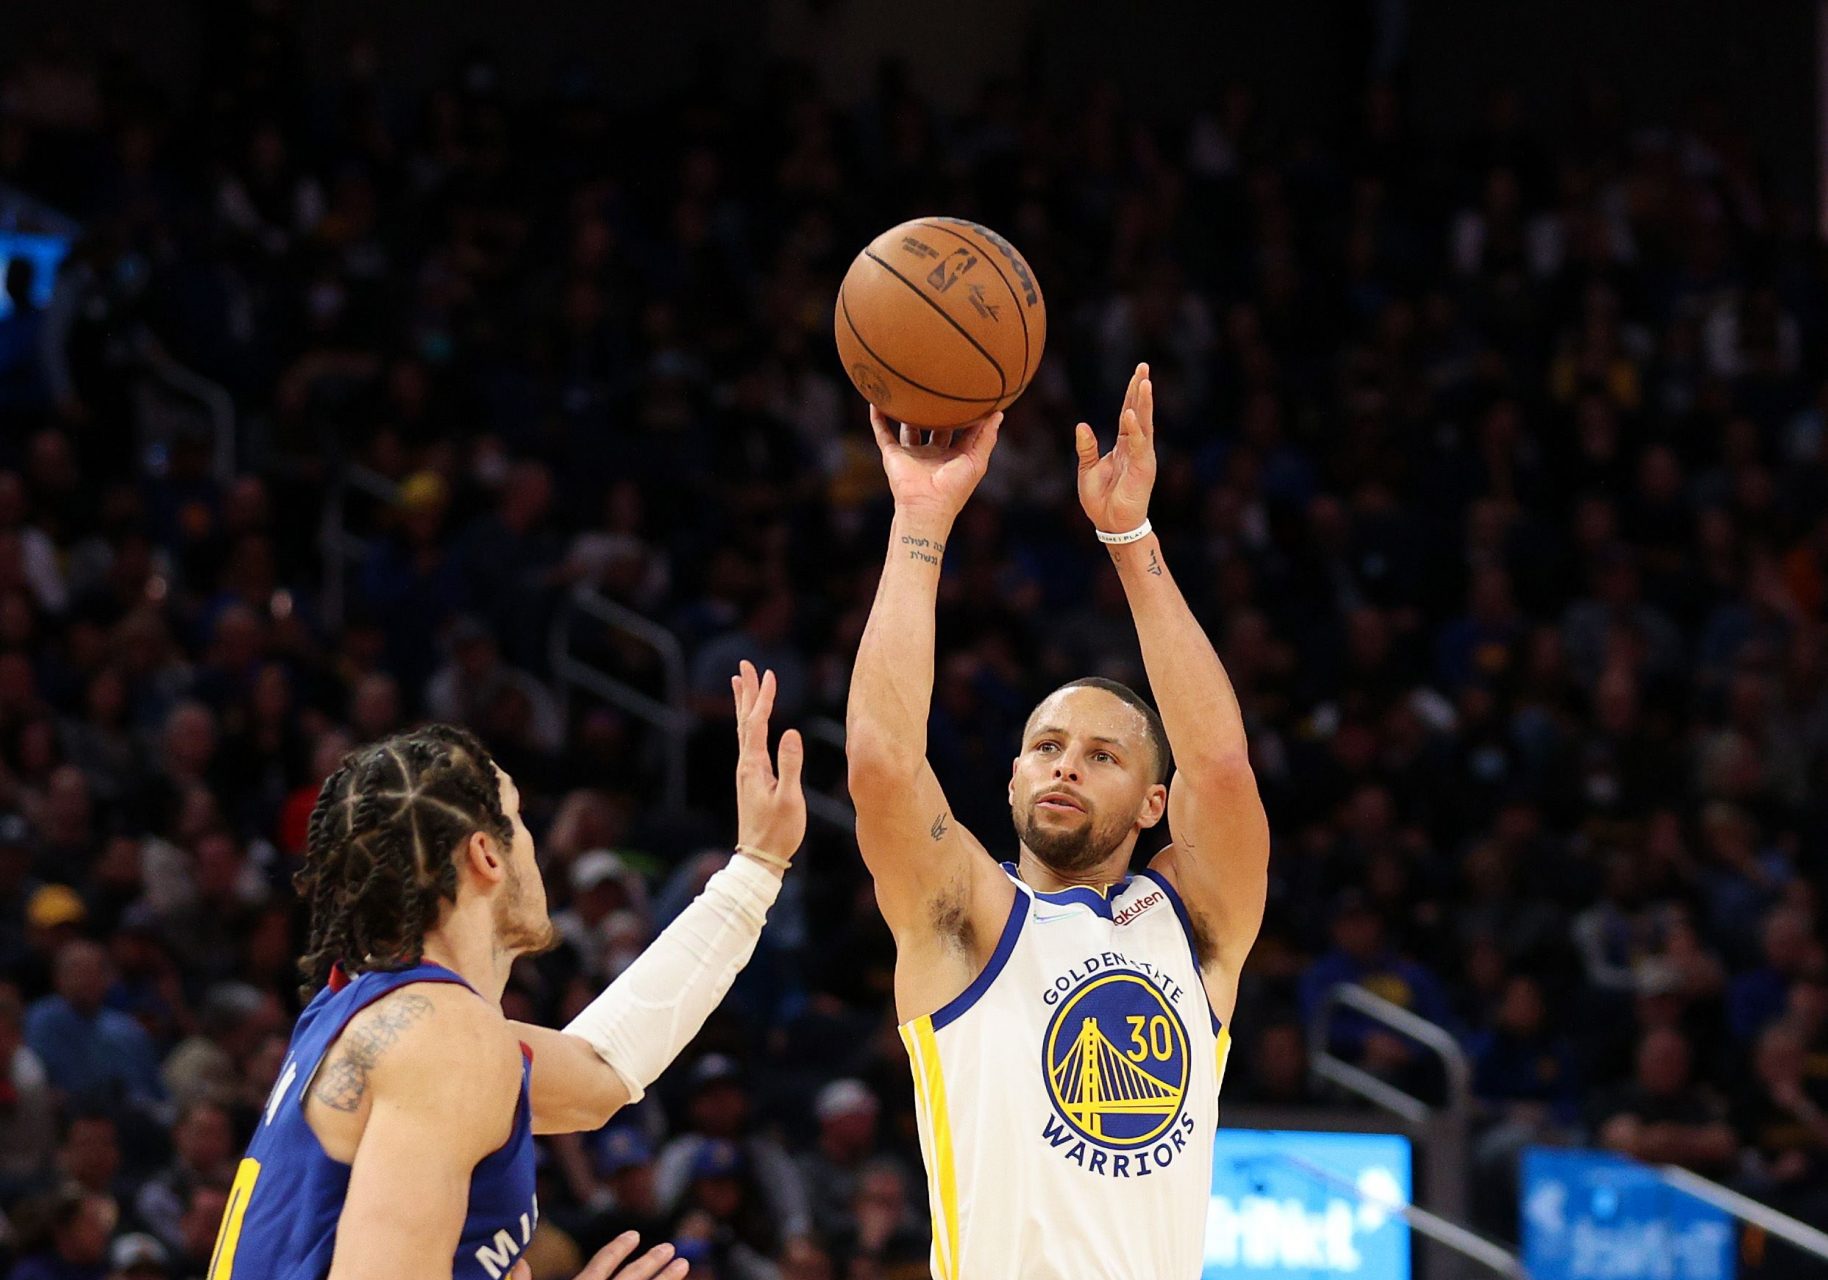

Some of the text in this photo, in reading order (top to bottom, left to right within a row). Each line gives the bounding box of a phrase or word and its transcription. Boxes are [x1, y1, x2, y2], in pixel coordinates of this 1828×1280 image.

[1112, 891, 1164, 926] akuten
[1043, 951, 1127, 1005] GOLDEN
[1126, 1014, 1173, 1062] 30
[1042, 1111, 1194, 1178] WARRIORS
